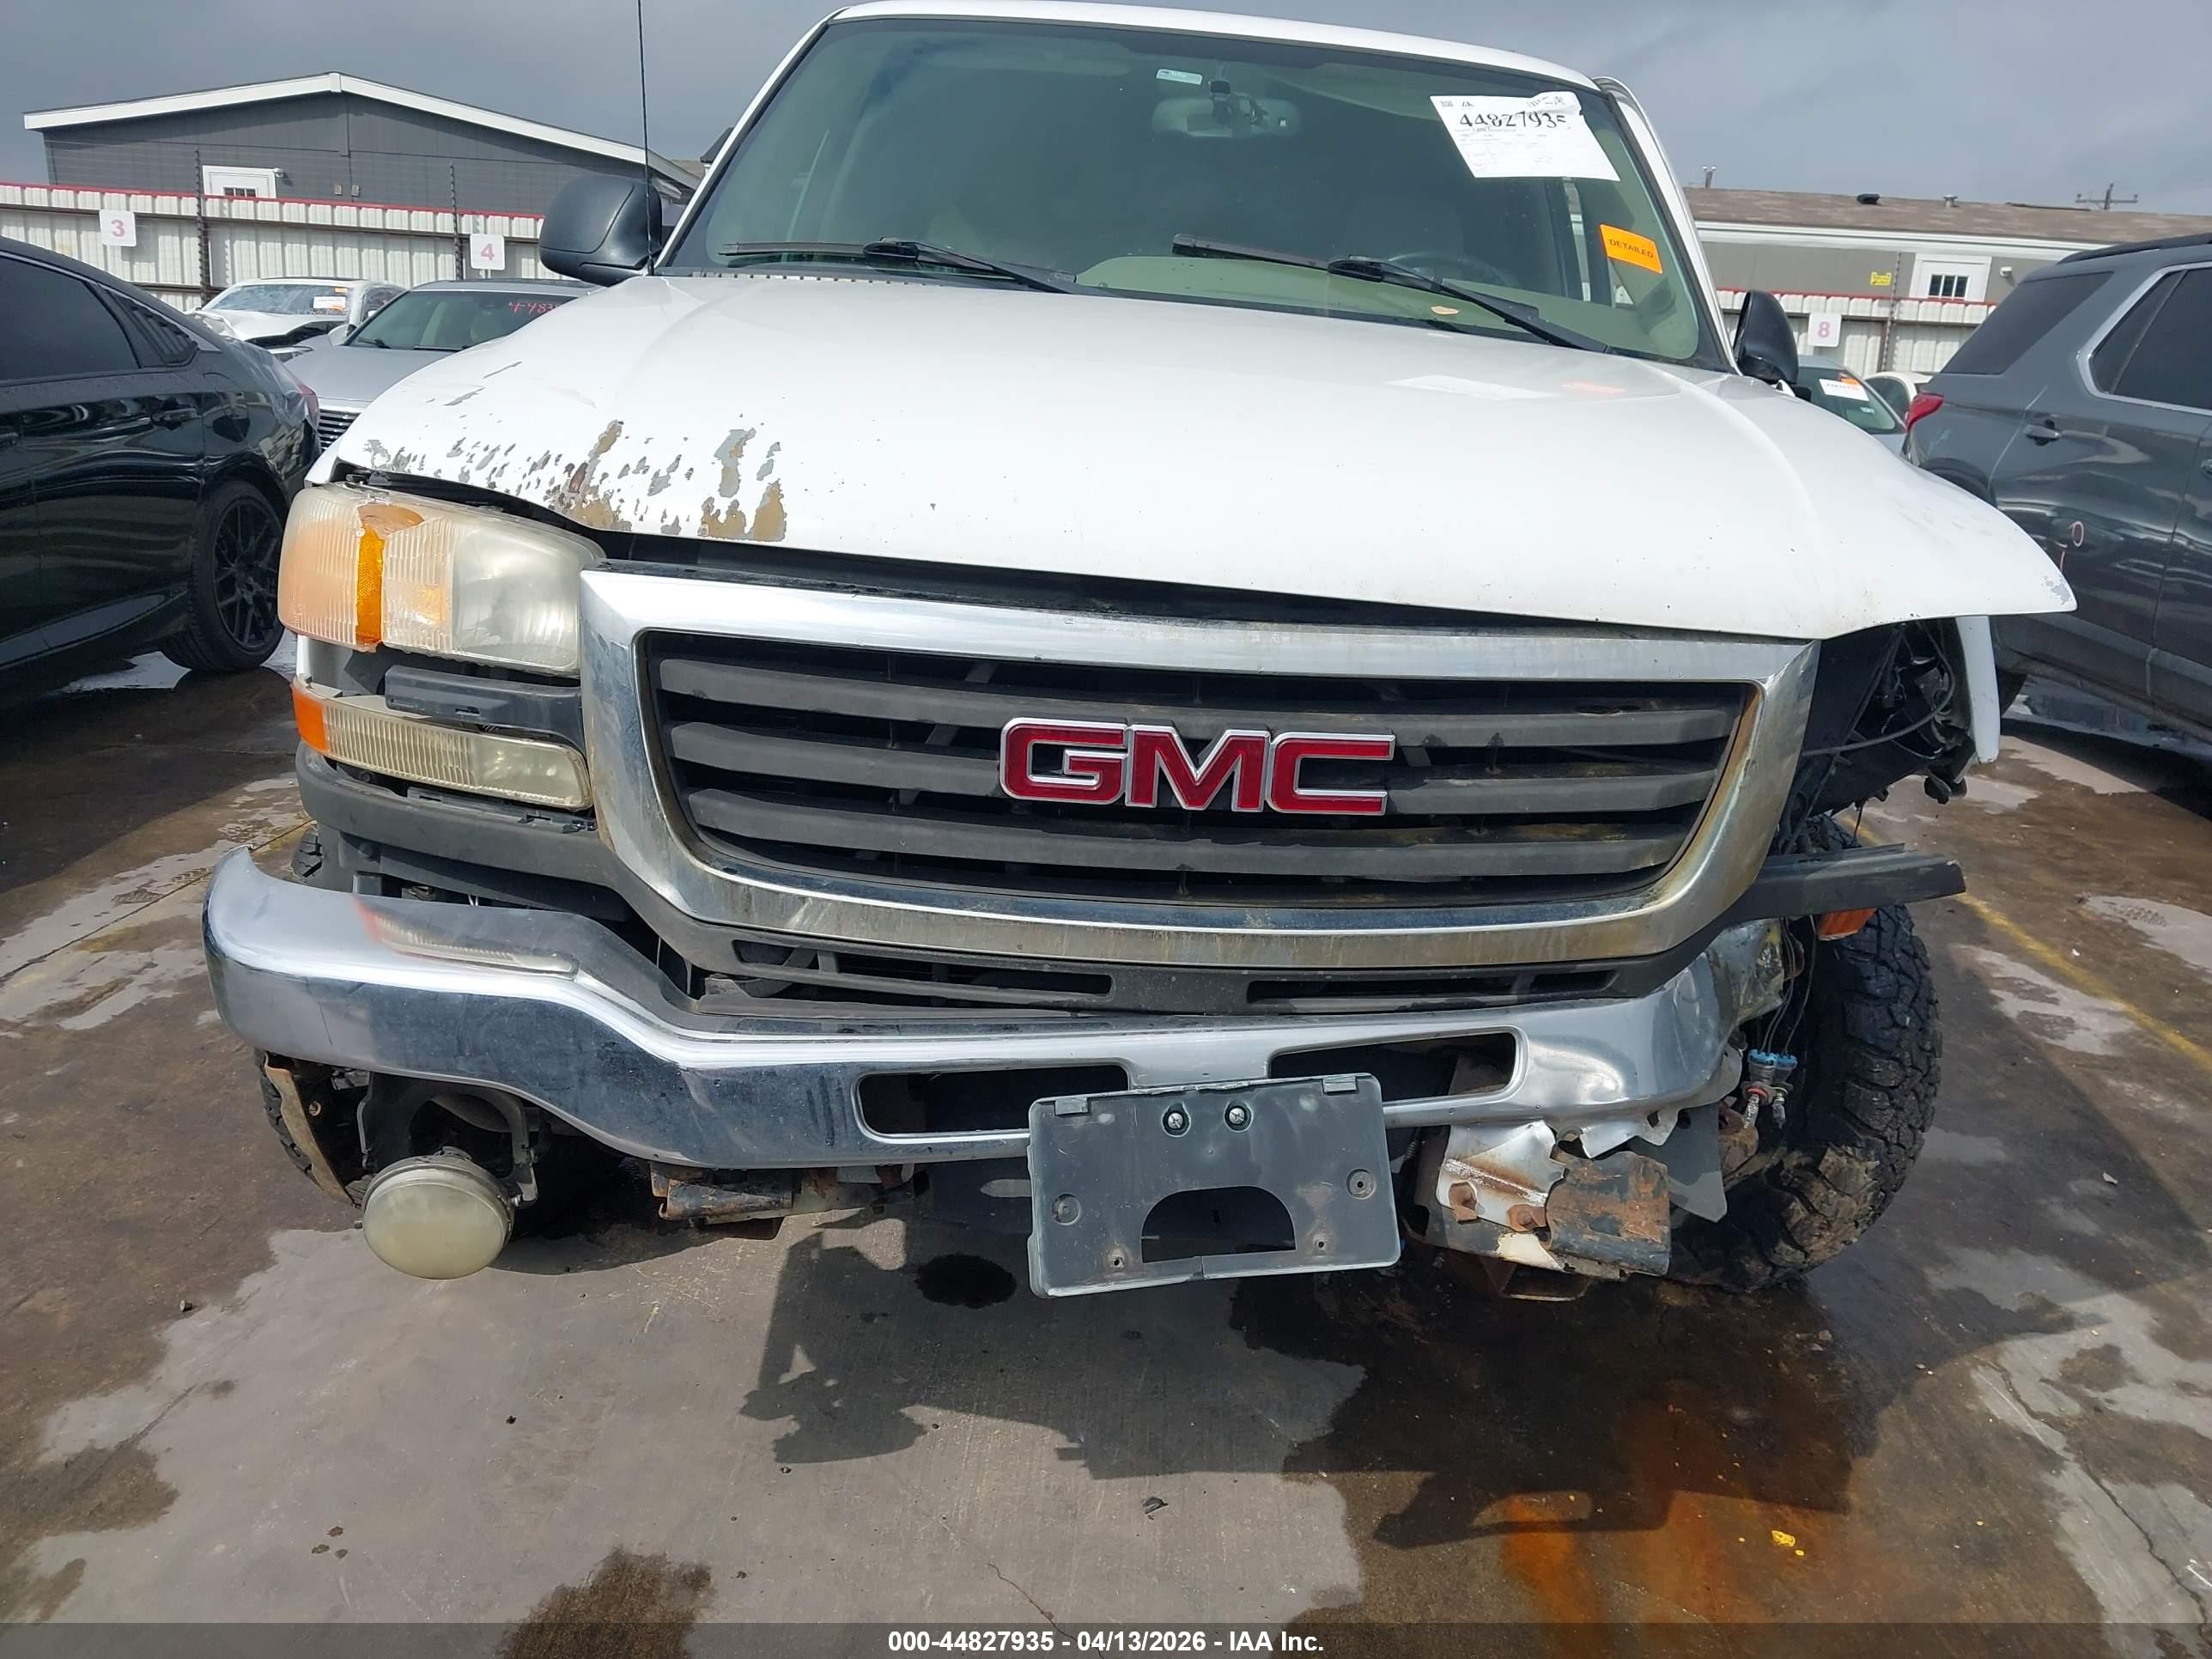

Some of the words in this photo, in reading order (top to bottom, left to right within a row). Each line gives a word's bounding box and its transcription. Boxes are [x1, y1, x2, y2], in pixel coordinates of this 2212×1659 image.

[111, 219, 125, 237] 3
[480, 243, 495, 261] 4
[1609, 240, 1654, 258] DETAILED
[1818, 321, 1831, 338] 8
[1000, 717, 1396, 816] GMC
